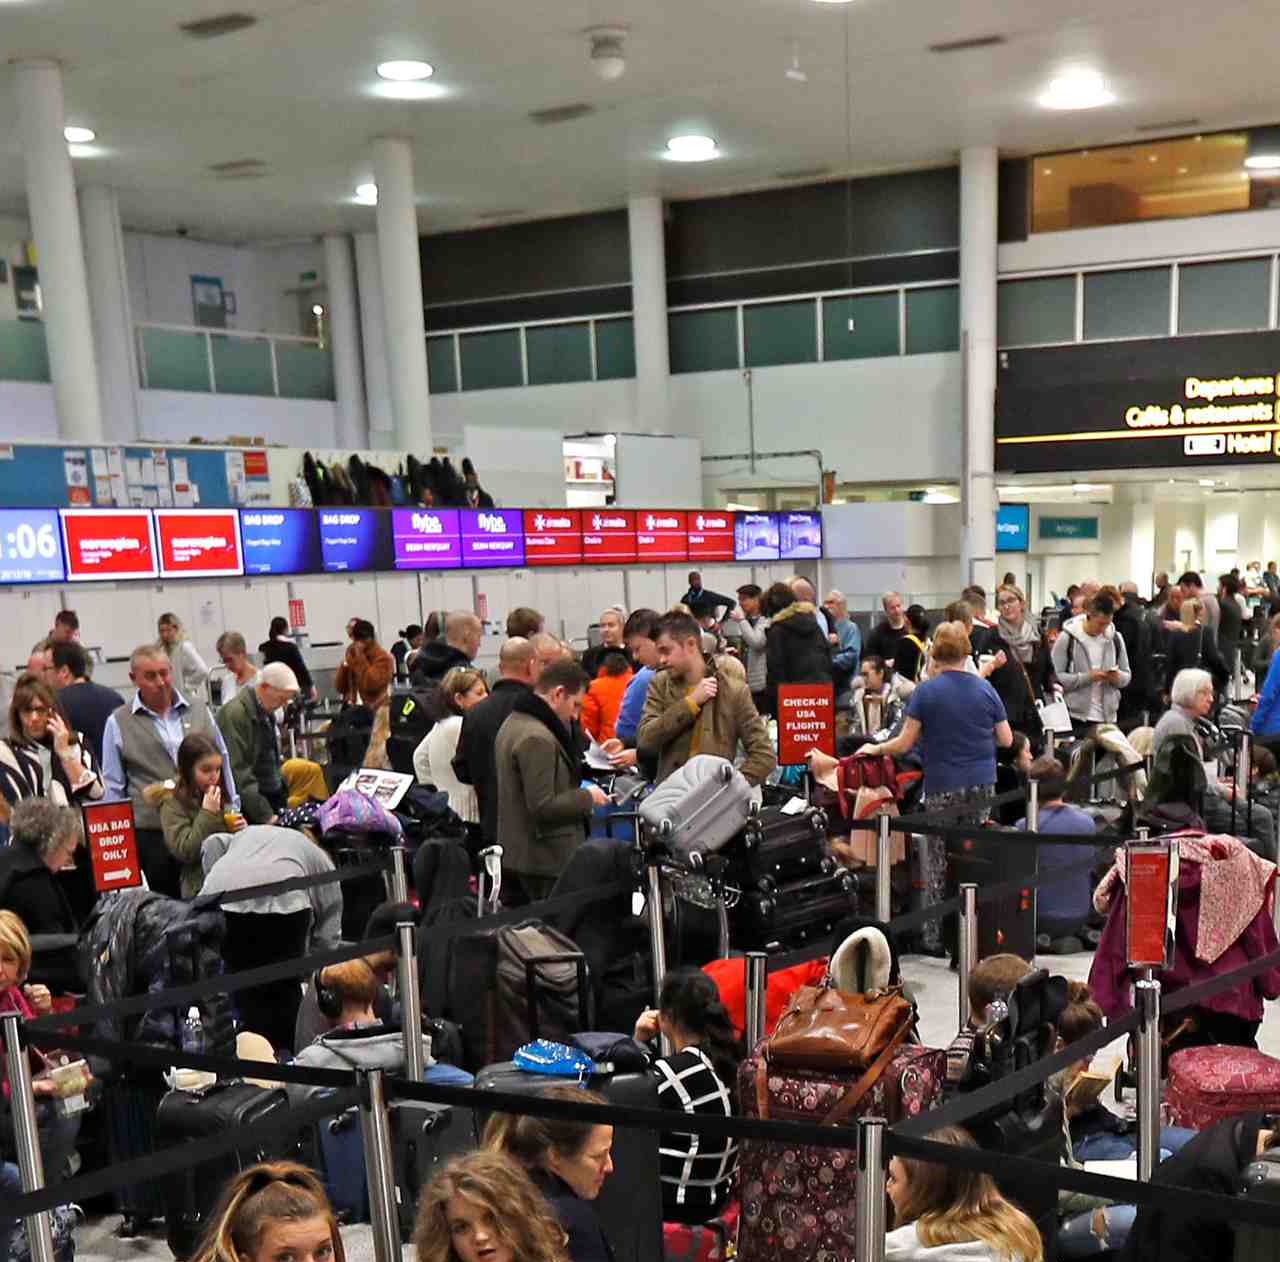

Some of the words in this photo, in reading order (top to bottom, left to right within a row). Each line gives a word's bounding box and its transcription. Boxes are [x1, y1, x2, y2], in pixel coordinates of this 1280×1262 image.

[1185, 376, 1275, 401] Departures
[1227, 432, 1272, 453] Hotel
[79, 536, 140, 552] norwegian
[171, 535, 227, 550] norwegian
[783, 698, 829, 707] CHECK-IN
[796, 710, 816, 719] USA
[786, 721, 826, 731] FLIGHTS
[793, 733, 819, 742] ONLY
[89, 822, 110, 834] USA
[111, 820, 130, 831] BAG
[99, 835, 125, 847] DROP
[103, 848, 128, 862] ONLY
